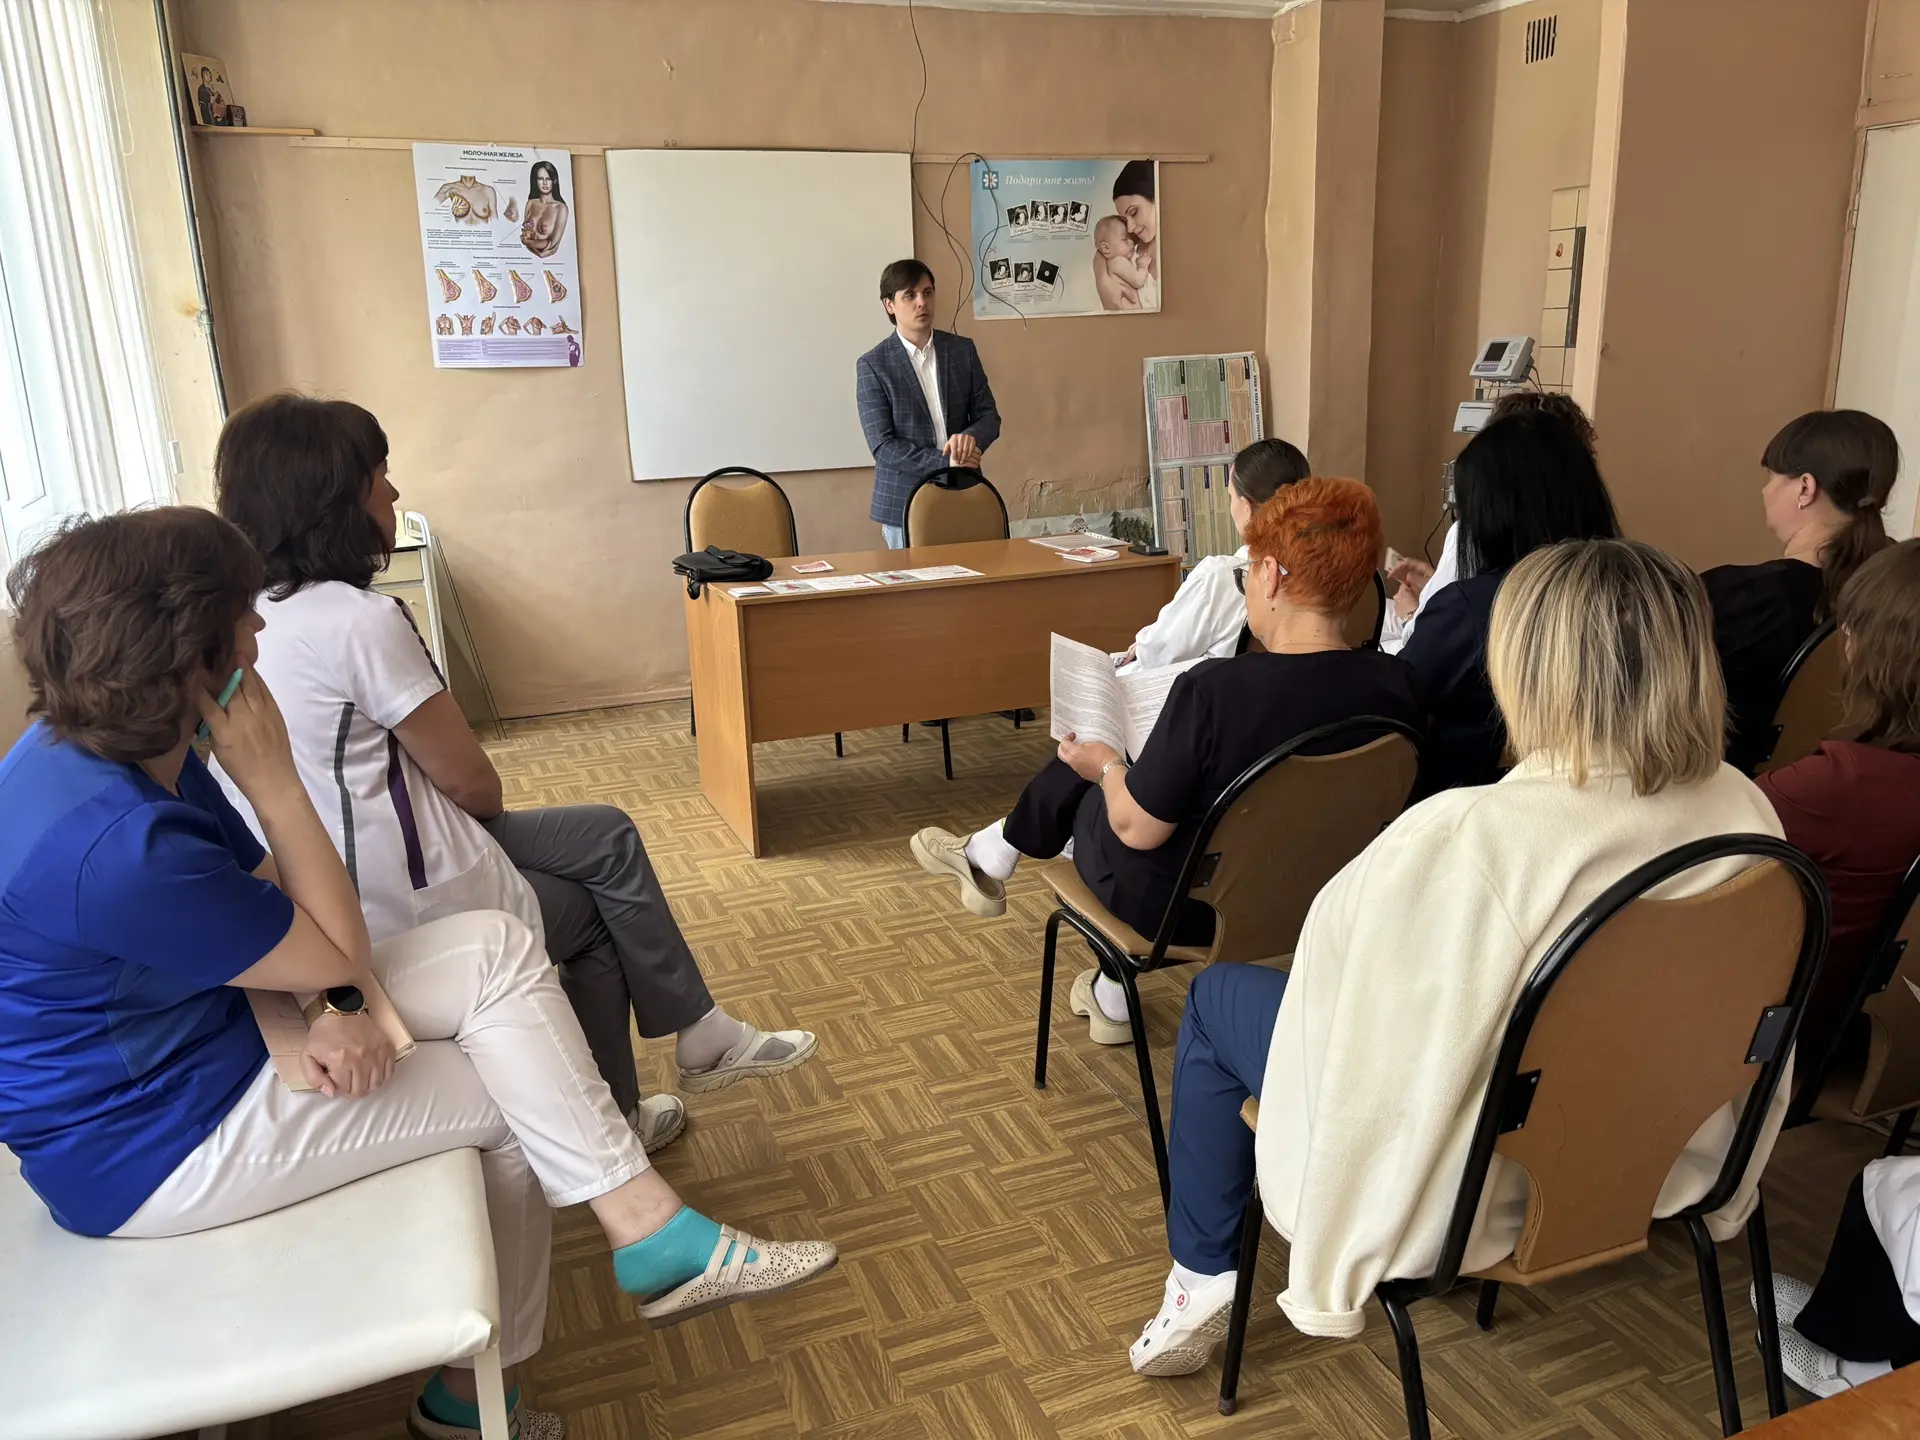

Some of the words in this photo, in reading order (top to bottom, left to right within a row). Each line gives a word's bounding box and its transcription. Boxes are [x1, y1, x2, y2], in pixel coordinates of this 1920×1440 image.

[1005, 174, 1041, 187] Подари
[1043, 177, 1061, 185] мне
[1063, 175, 1095, 185] жизнь!
